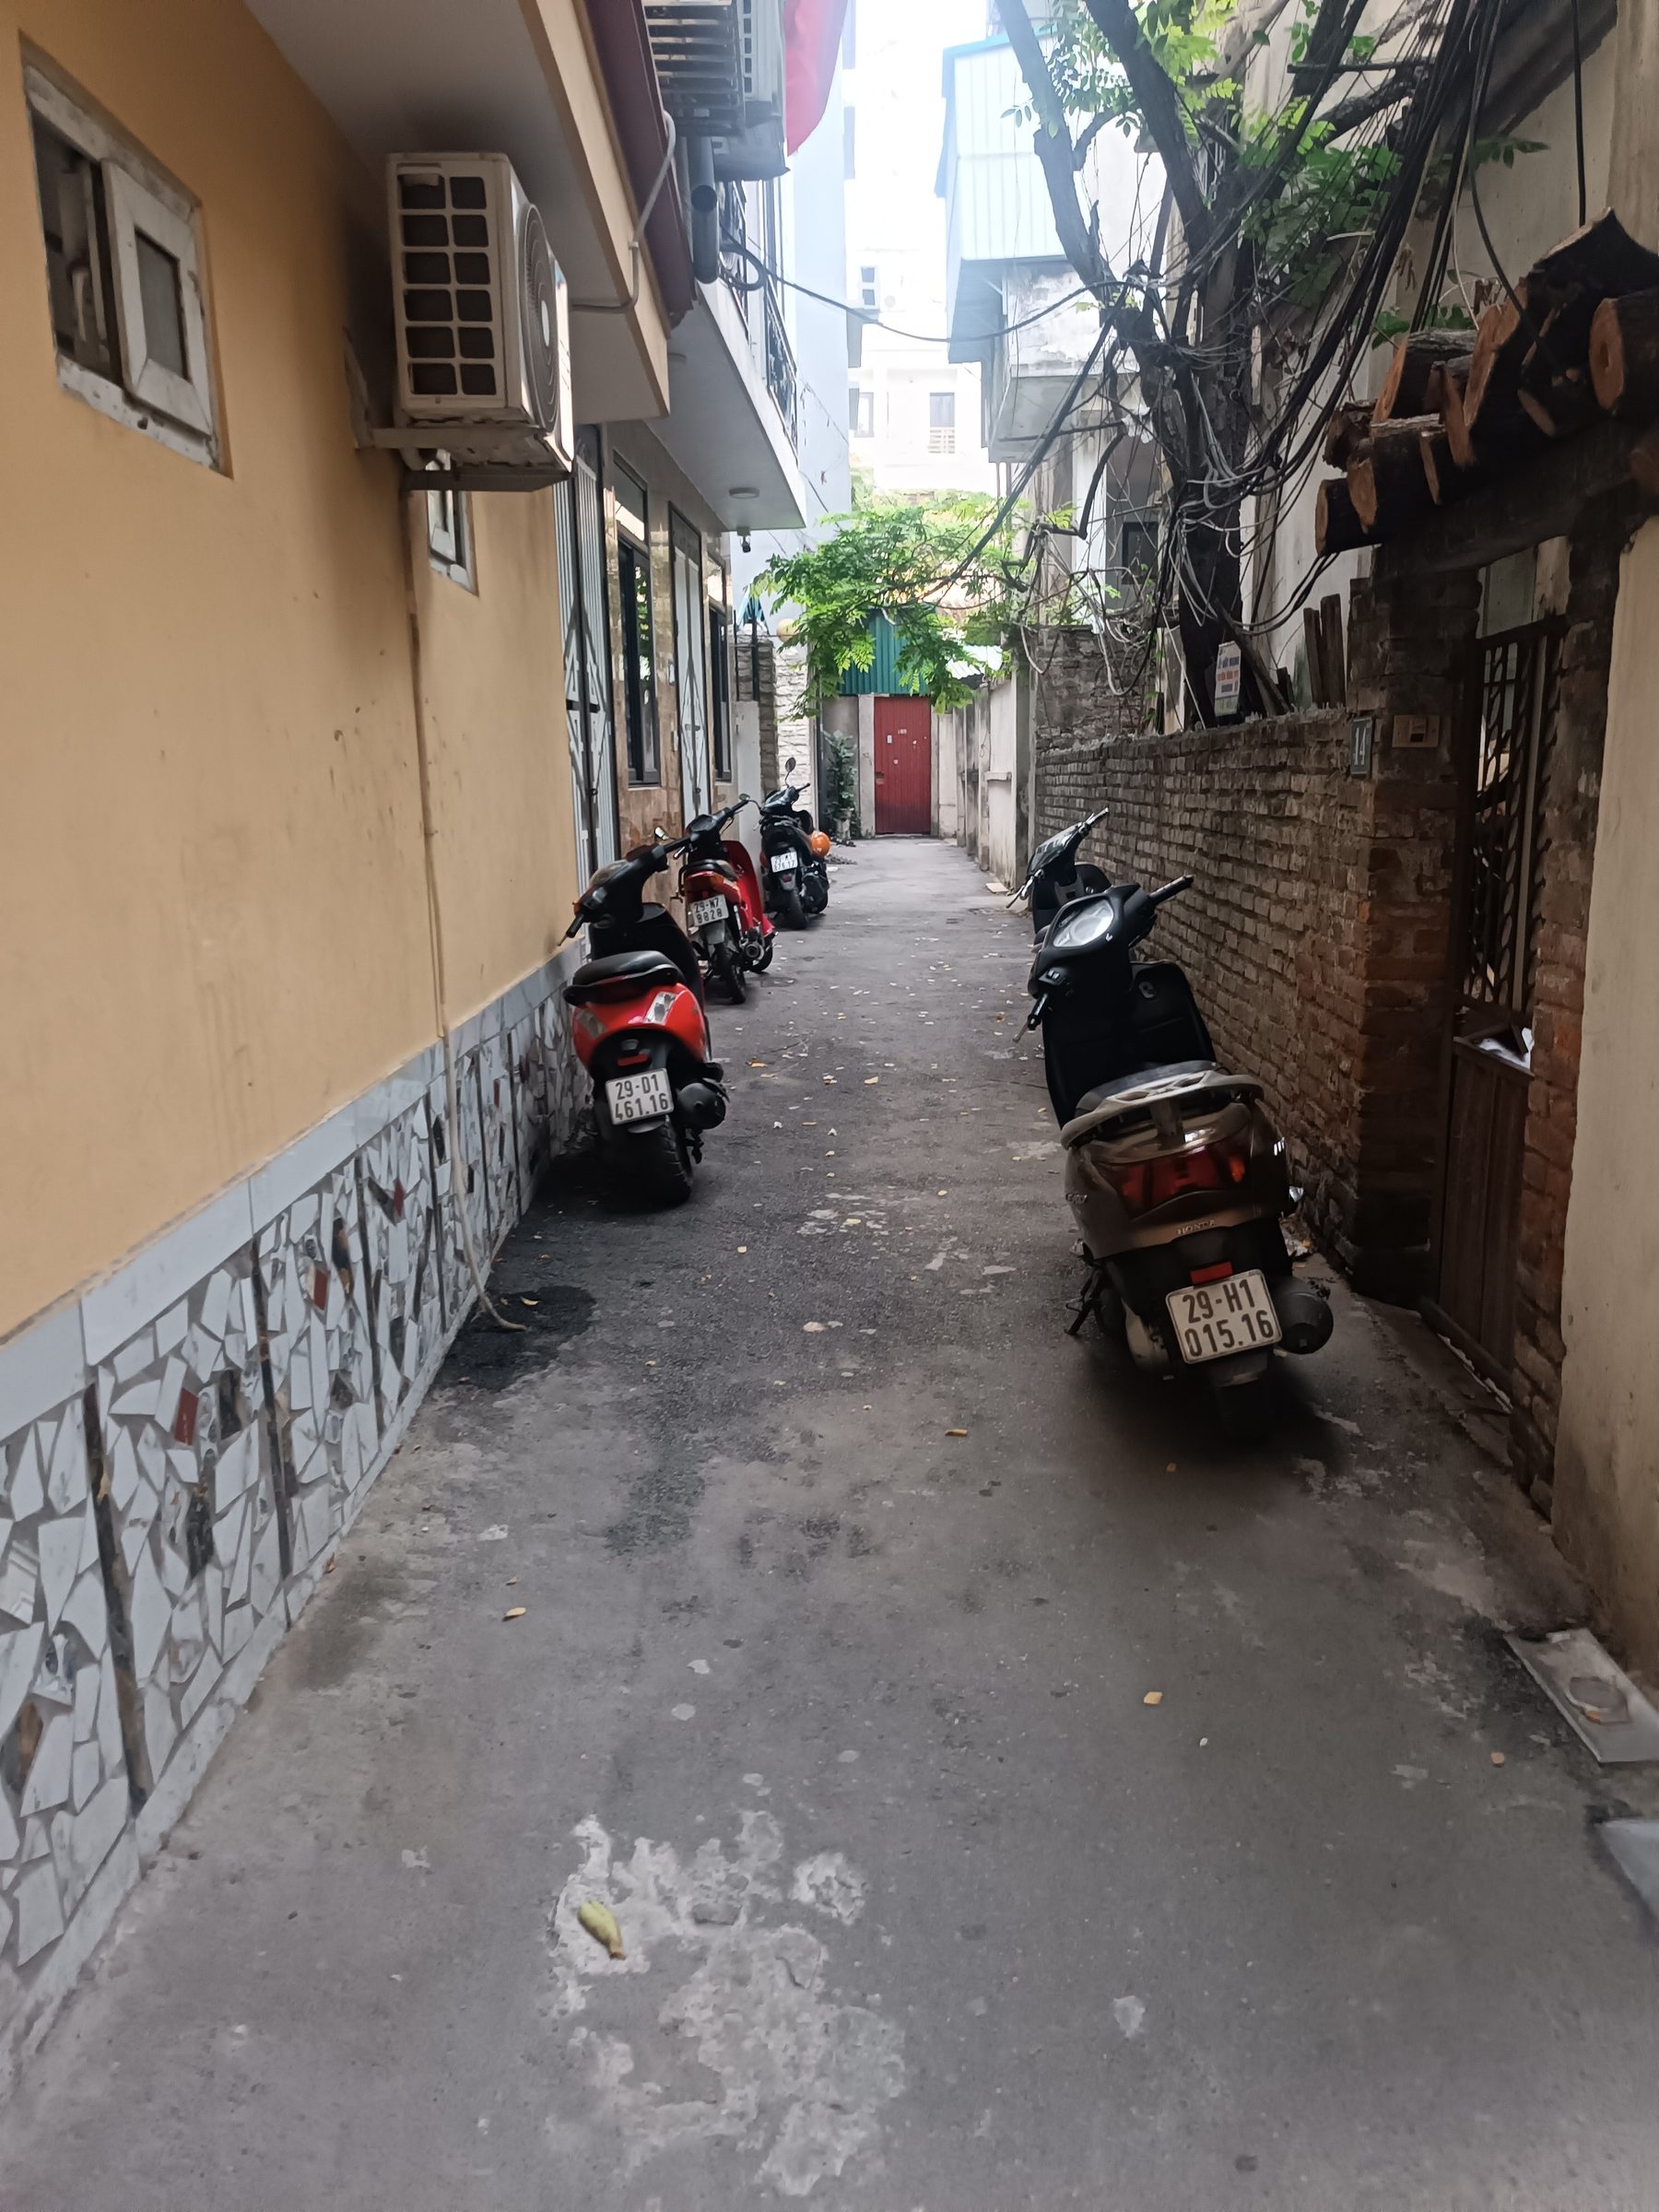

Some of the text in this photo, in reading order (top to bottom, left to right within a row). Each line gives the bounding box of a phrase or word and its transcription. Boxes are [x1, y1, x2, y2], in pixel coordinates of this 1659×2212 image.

[1355, 727, 1367, 765] 14
[616, 1074, 659, 1100] 29-D1
[615, 1093, 668, 1121] 461.16
[1182, 1278, 1255, 1324] 29-H1
[1184, 1310, 1274, 1358] 015.16
